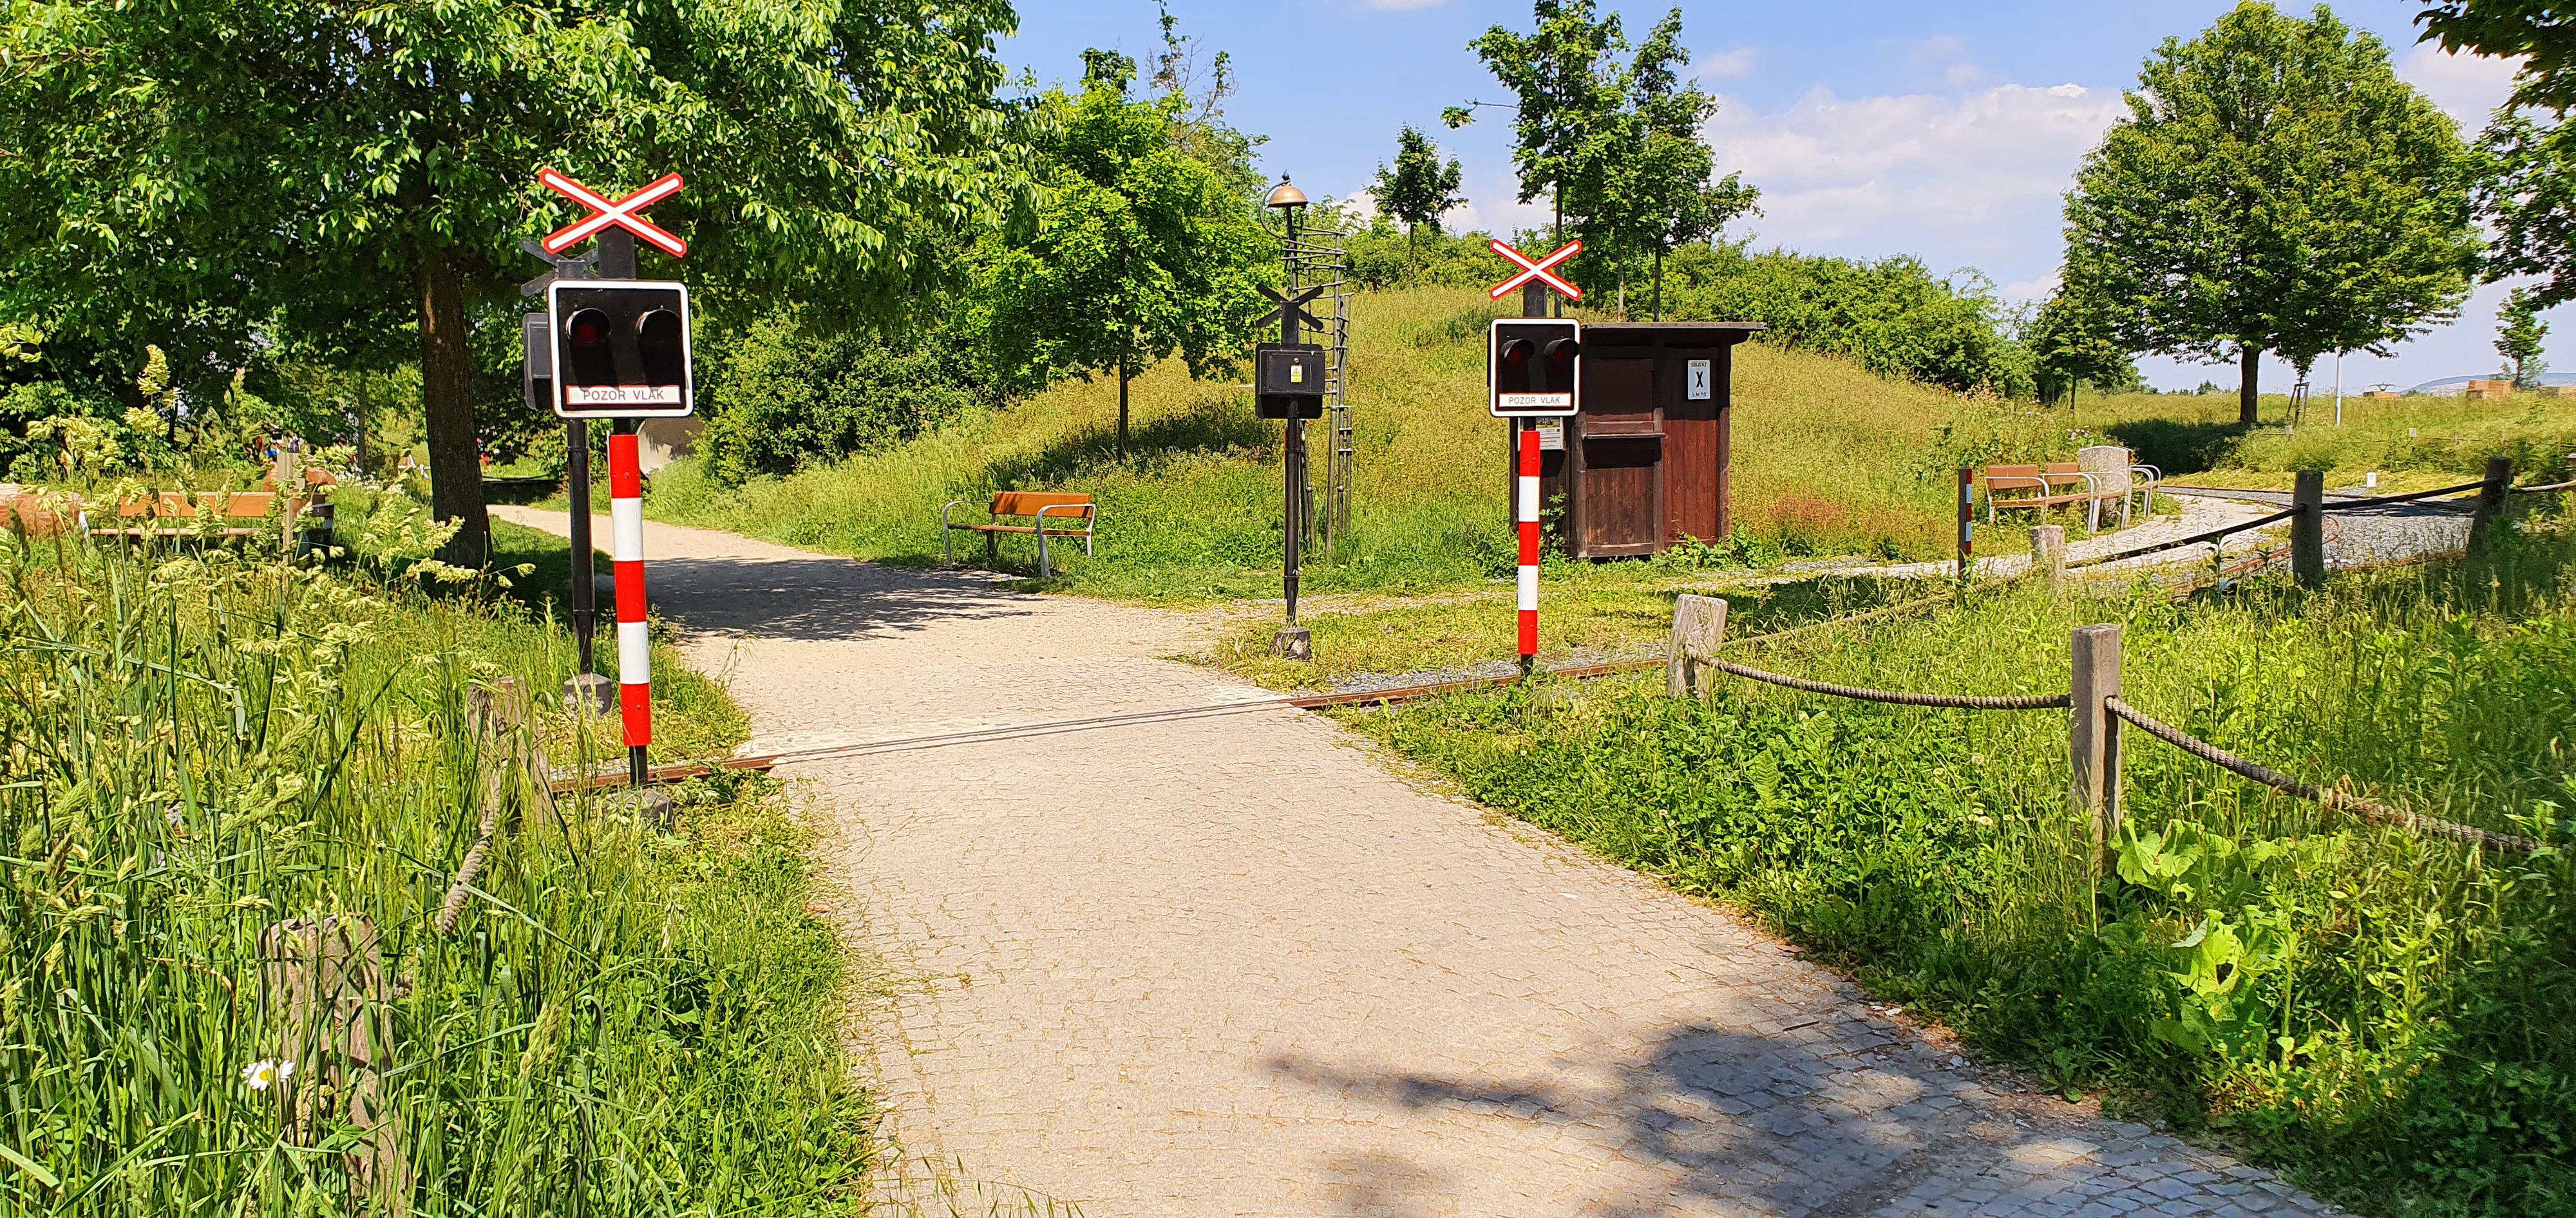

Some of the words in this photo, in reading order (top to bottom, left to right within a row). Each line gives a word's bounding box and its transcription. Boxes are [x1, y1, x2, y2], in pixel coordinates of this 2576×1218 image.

[1696, 371, 1703, 388] X
[583, 389, 626, 400] POZOR
[632, 389, 665, 400] VLAK
